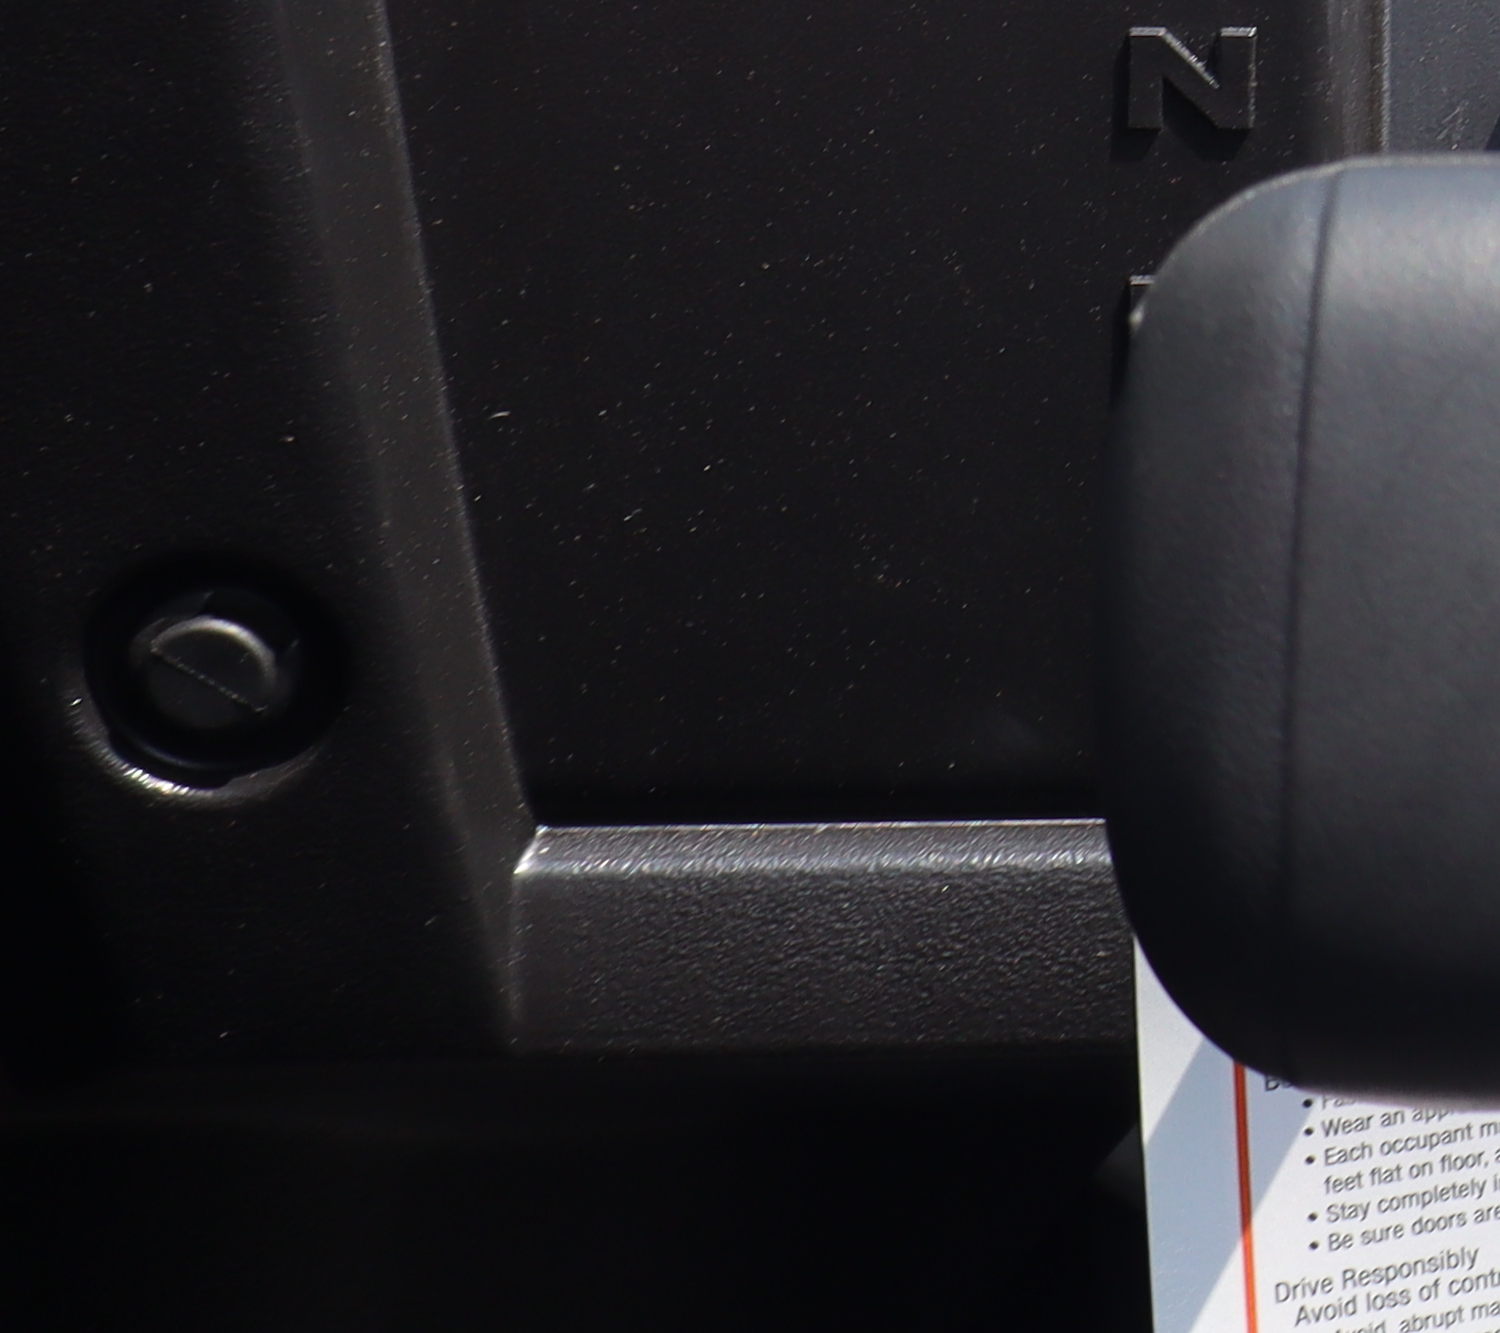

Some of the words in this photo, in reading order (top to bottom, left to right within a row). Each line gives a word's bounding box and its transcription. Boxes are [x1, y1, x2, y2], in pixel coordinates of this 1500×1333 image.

[1128, 26, 1256, 130] N
[1322, 1113, 1373, 1138] Wear
[1381, 1108, 1405, 1127] an
[1324, 1141, 1373, 1167] Each
[1379, 1121, 1473, 1156] occupant
[1324, 1169, 1367, 1196] feet
[1369, 1161, 1404, 1185] flat
[1409, 1161, 1434, 1180] on
[1440, 1146, 1490, 1175] floor,
[1326, 1197, 1371, 1225] Stay
[1377, 1175, 1488, 1215] completely
[1328, 1231, 1354, 1253] Be
[1361, 1223, 1405, 1246] sure
[1411, 1209, 1468, 1235] doors
[1274, 1276, 1335, 1305] Drive
[1341, 1245, 1481, 1290] Responsibly
[1294, 1295, 1358, 1328] Avoid
[1366, 1287, 1412, 1313] loss
[1419, 1277, 1442, 1302] of
[1399, 1304, 1465, 1333] abrupt
